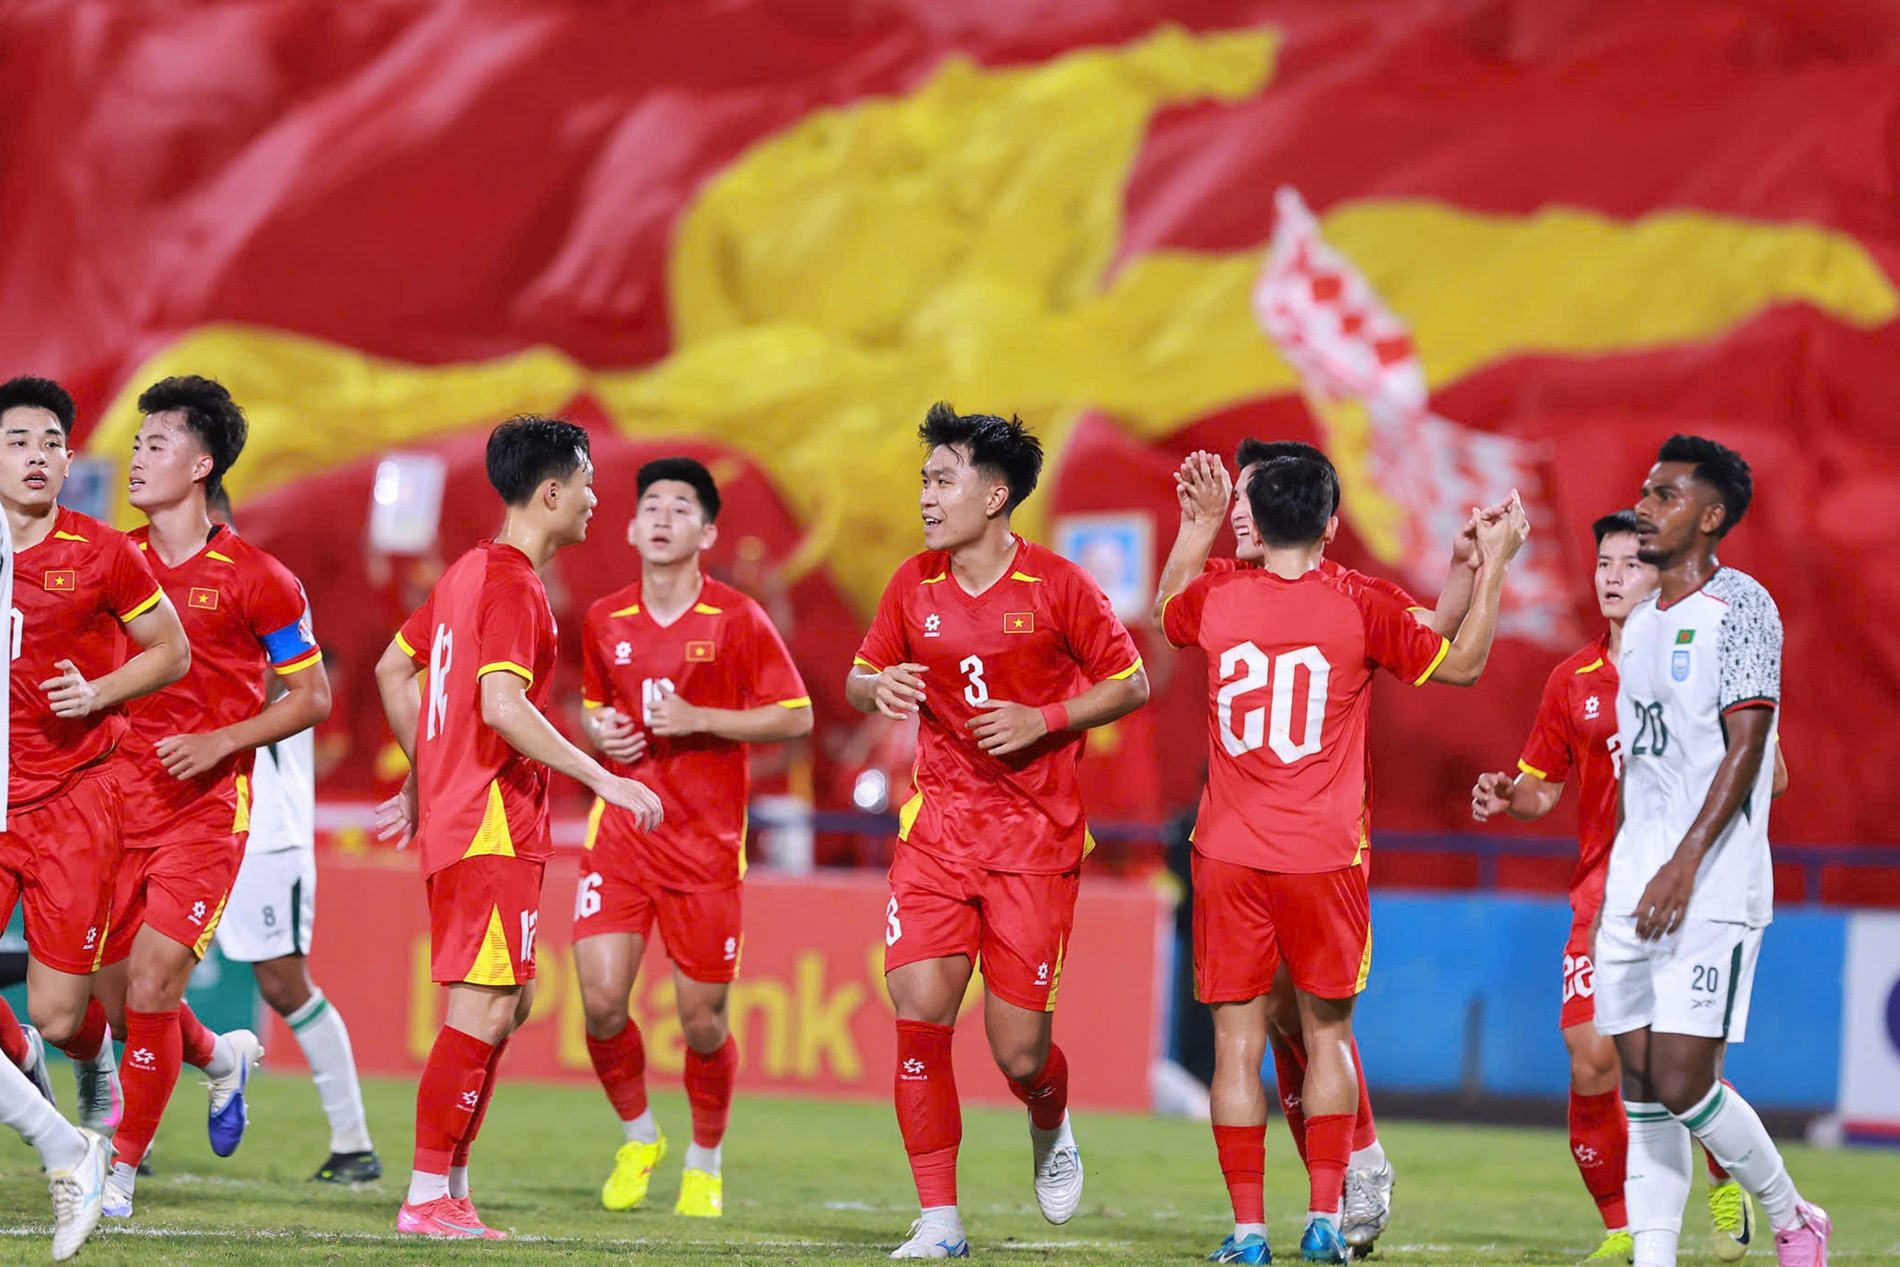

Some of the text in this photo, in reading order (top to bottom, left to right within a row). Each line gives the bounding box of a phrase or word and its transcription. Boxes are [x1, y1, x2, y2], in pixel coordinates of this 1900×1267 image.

[960, 654, 989, 707] 3
[1217, 640, 1331, 765] 20
[1632, 700, 1669, 757] 20
[263, 906, 276, 927] 8
[573, 871, 603, 922] 16
[886, 894, 902, 947] 3
[1692, 964, 1719, 993] 20
